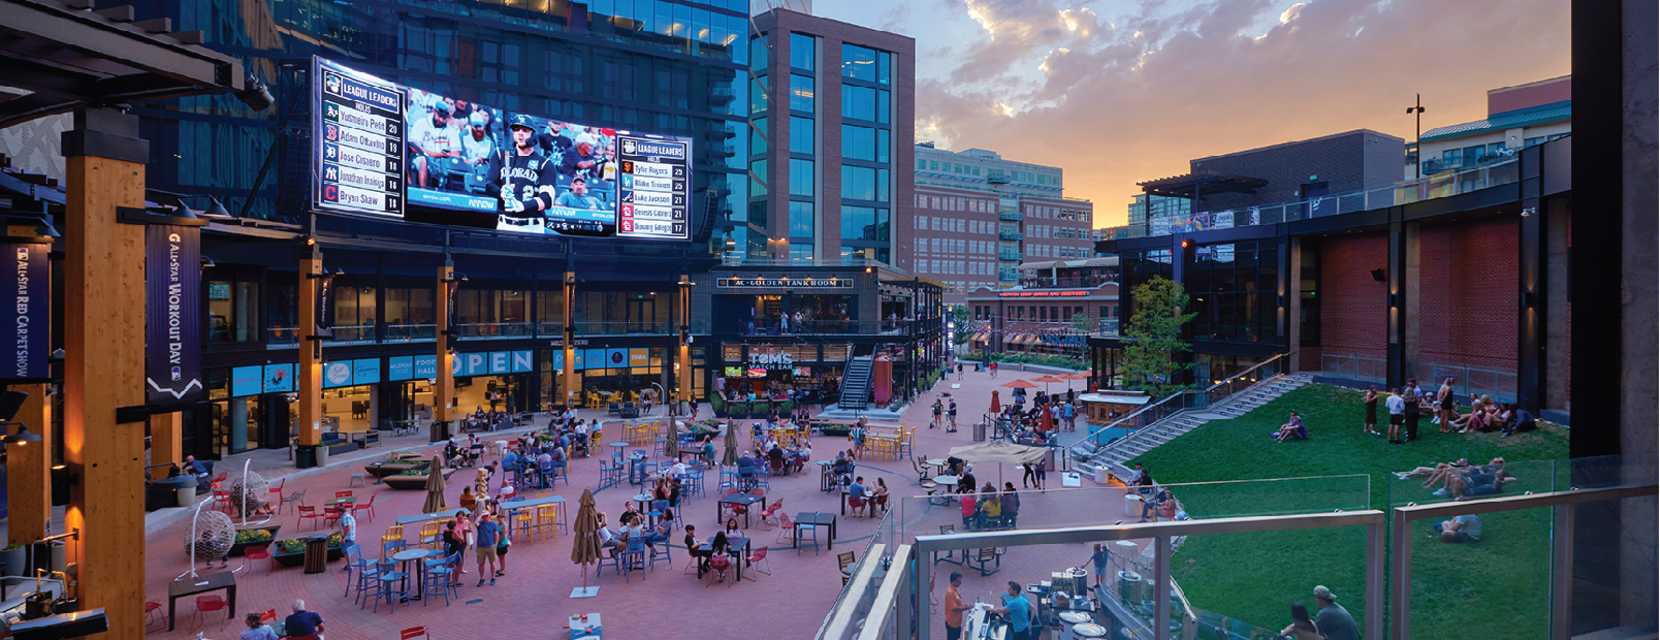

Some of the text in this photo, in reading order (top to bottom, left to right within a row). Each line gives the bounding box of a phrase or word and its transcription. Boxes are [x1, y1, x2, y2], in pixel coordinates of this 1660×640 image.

[343, 83, 397, 107] LEAGUE LEADERS
[638, 144, 658, 154] LEAGUE
[360, 194, 378, 205] Shaw
[674, 224, 682, 232] 17
[17, 296, 30, 314] RED
[168, 283, 182, 341] WORKOUT
[17, 315, 30, 350] CARPET
[16, 350, 29, 377] SHOW
[169, 342, 182, 365] DAY
